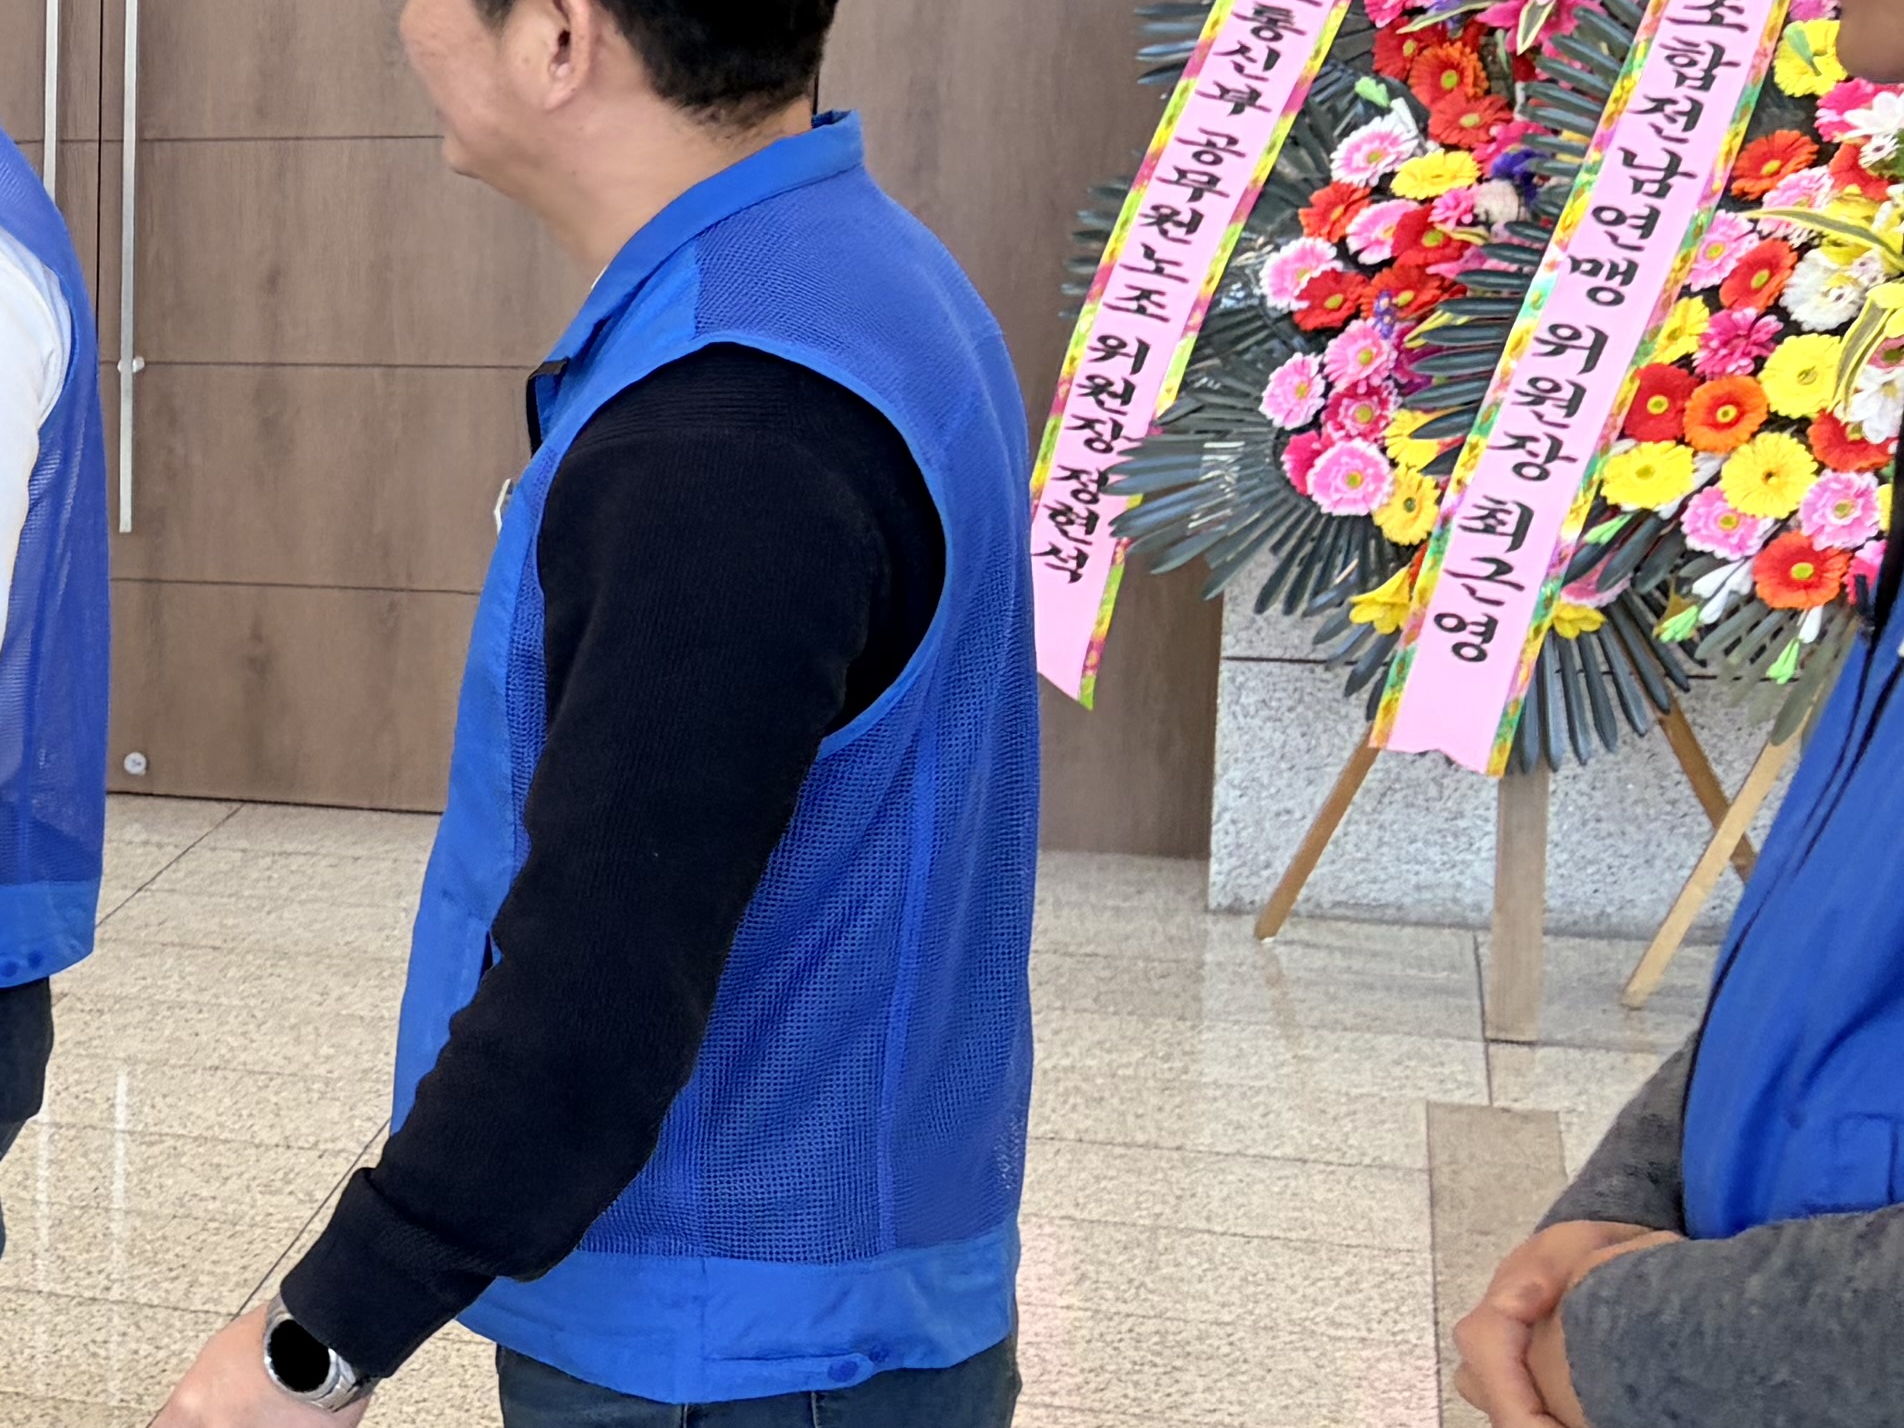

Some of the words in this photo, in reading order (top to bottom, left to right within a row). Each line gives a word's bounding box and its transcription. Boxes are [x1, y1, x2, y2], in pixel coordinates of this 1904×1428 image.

[1102, 126, 1247, 324] 공무원노조
[1064, 333, 1149, 454] 위원장
[1487, 321, 1609, 484] 위원장
[1030, 464, 1110, 584] 정현석
[1433, 497, 1534, 665] 최근영
